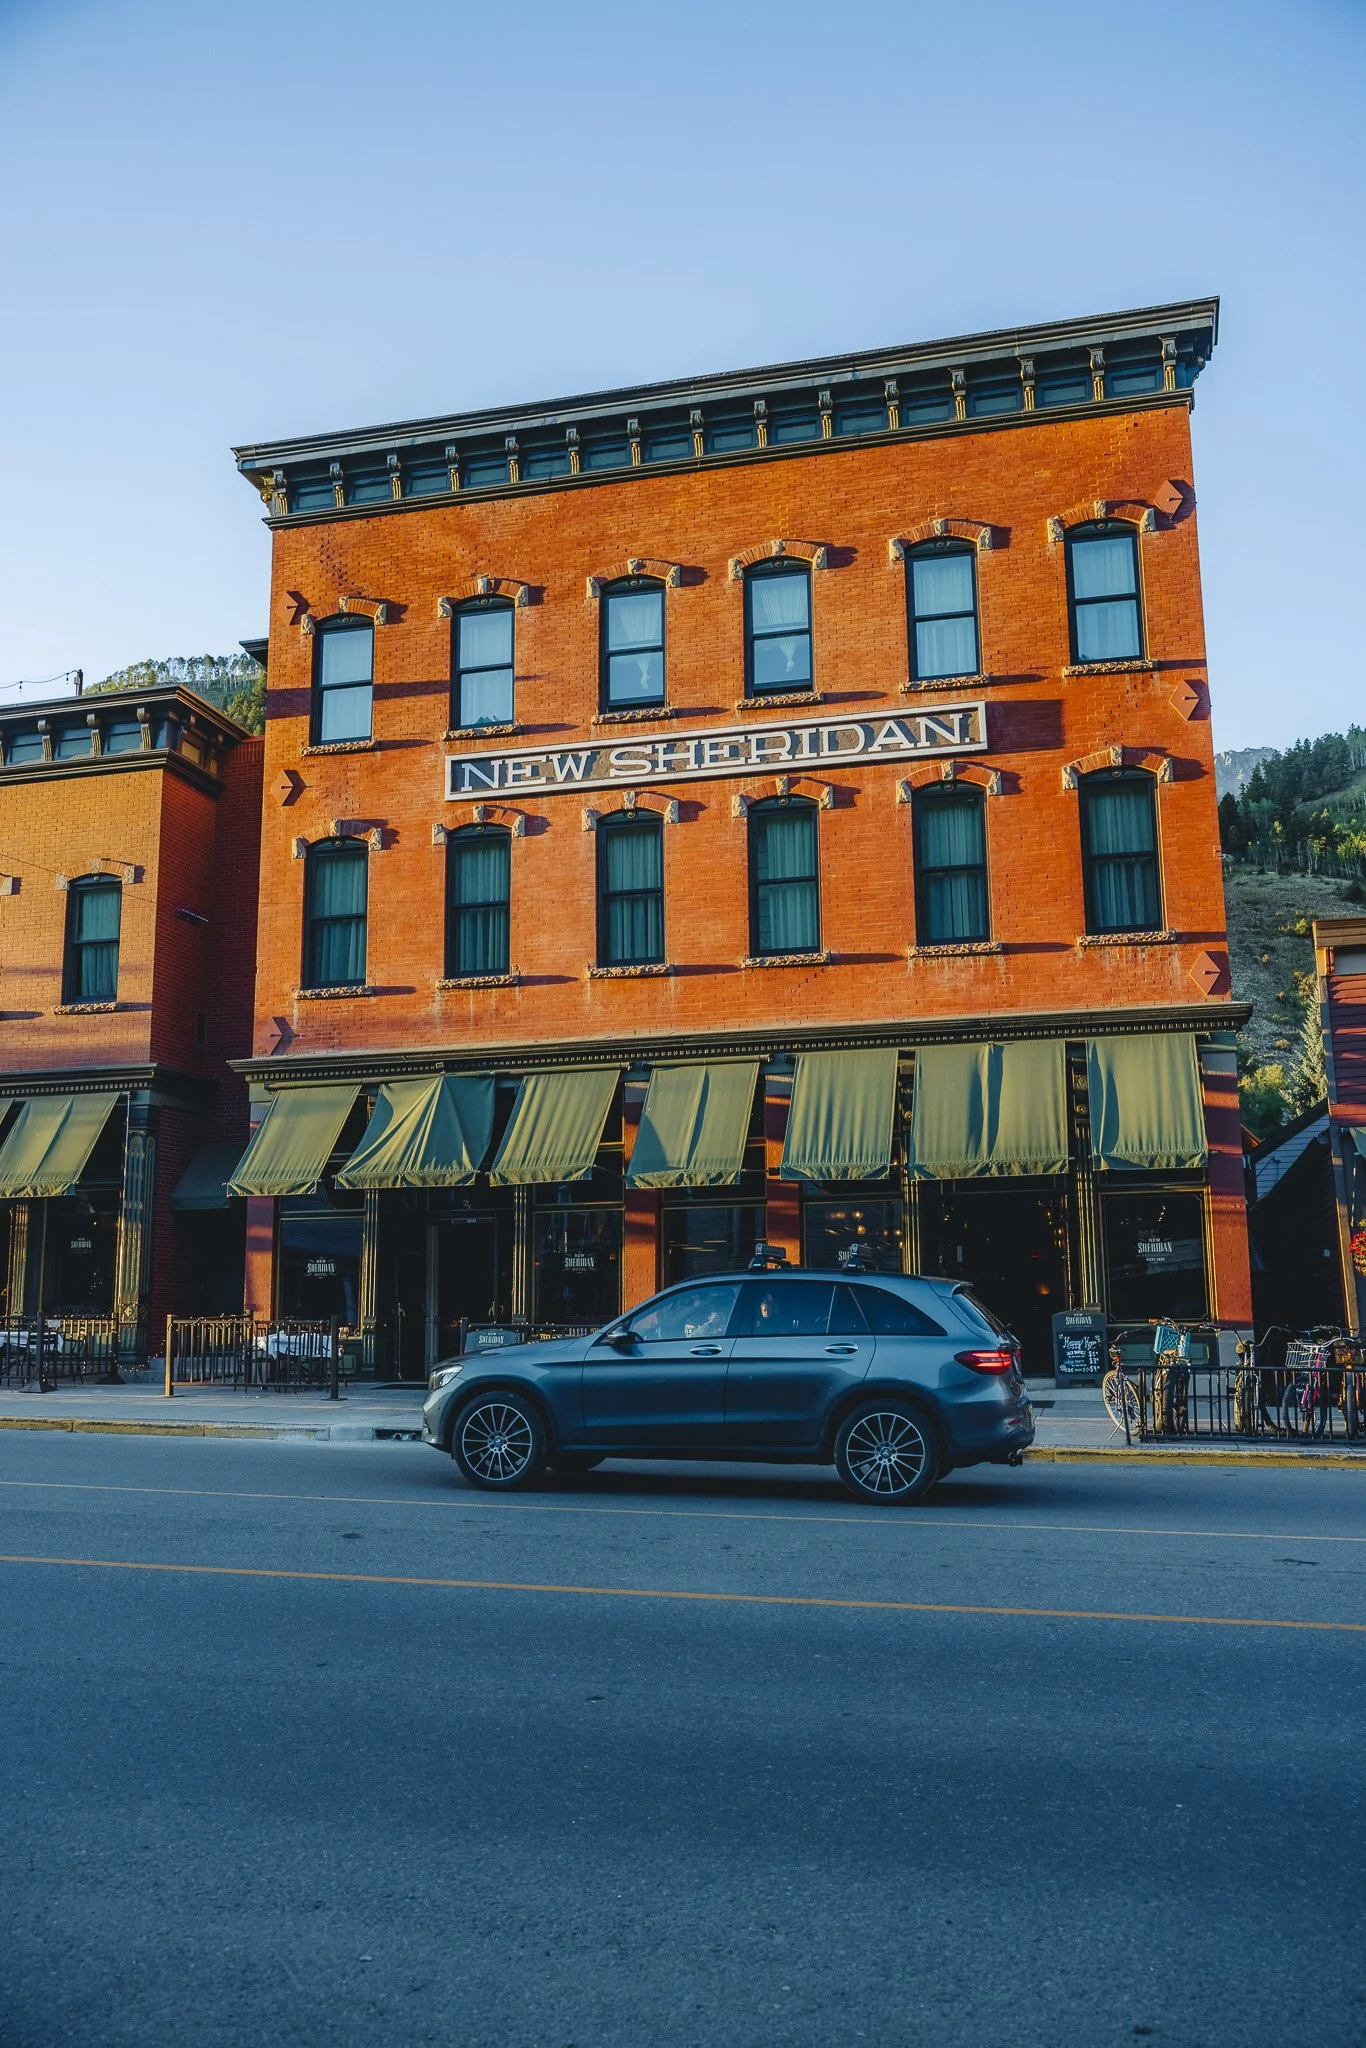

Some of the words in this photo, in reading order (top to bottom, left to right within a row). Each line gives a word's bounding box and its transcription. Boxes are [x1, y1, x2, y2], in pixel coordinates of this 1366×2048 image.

[460, 750, 592, 792] NEW
[1137, 1241, 1173, 1254] SHERIDAN
[307, 1262, 335, 1273] SHERIDAN
[564, 1257, 595, 1268] SHERIDAN
